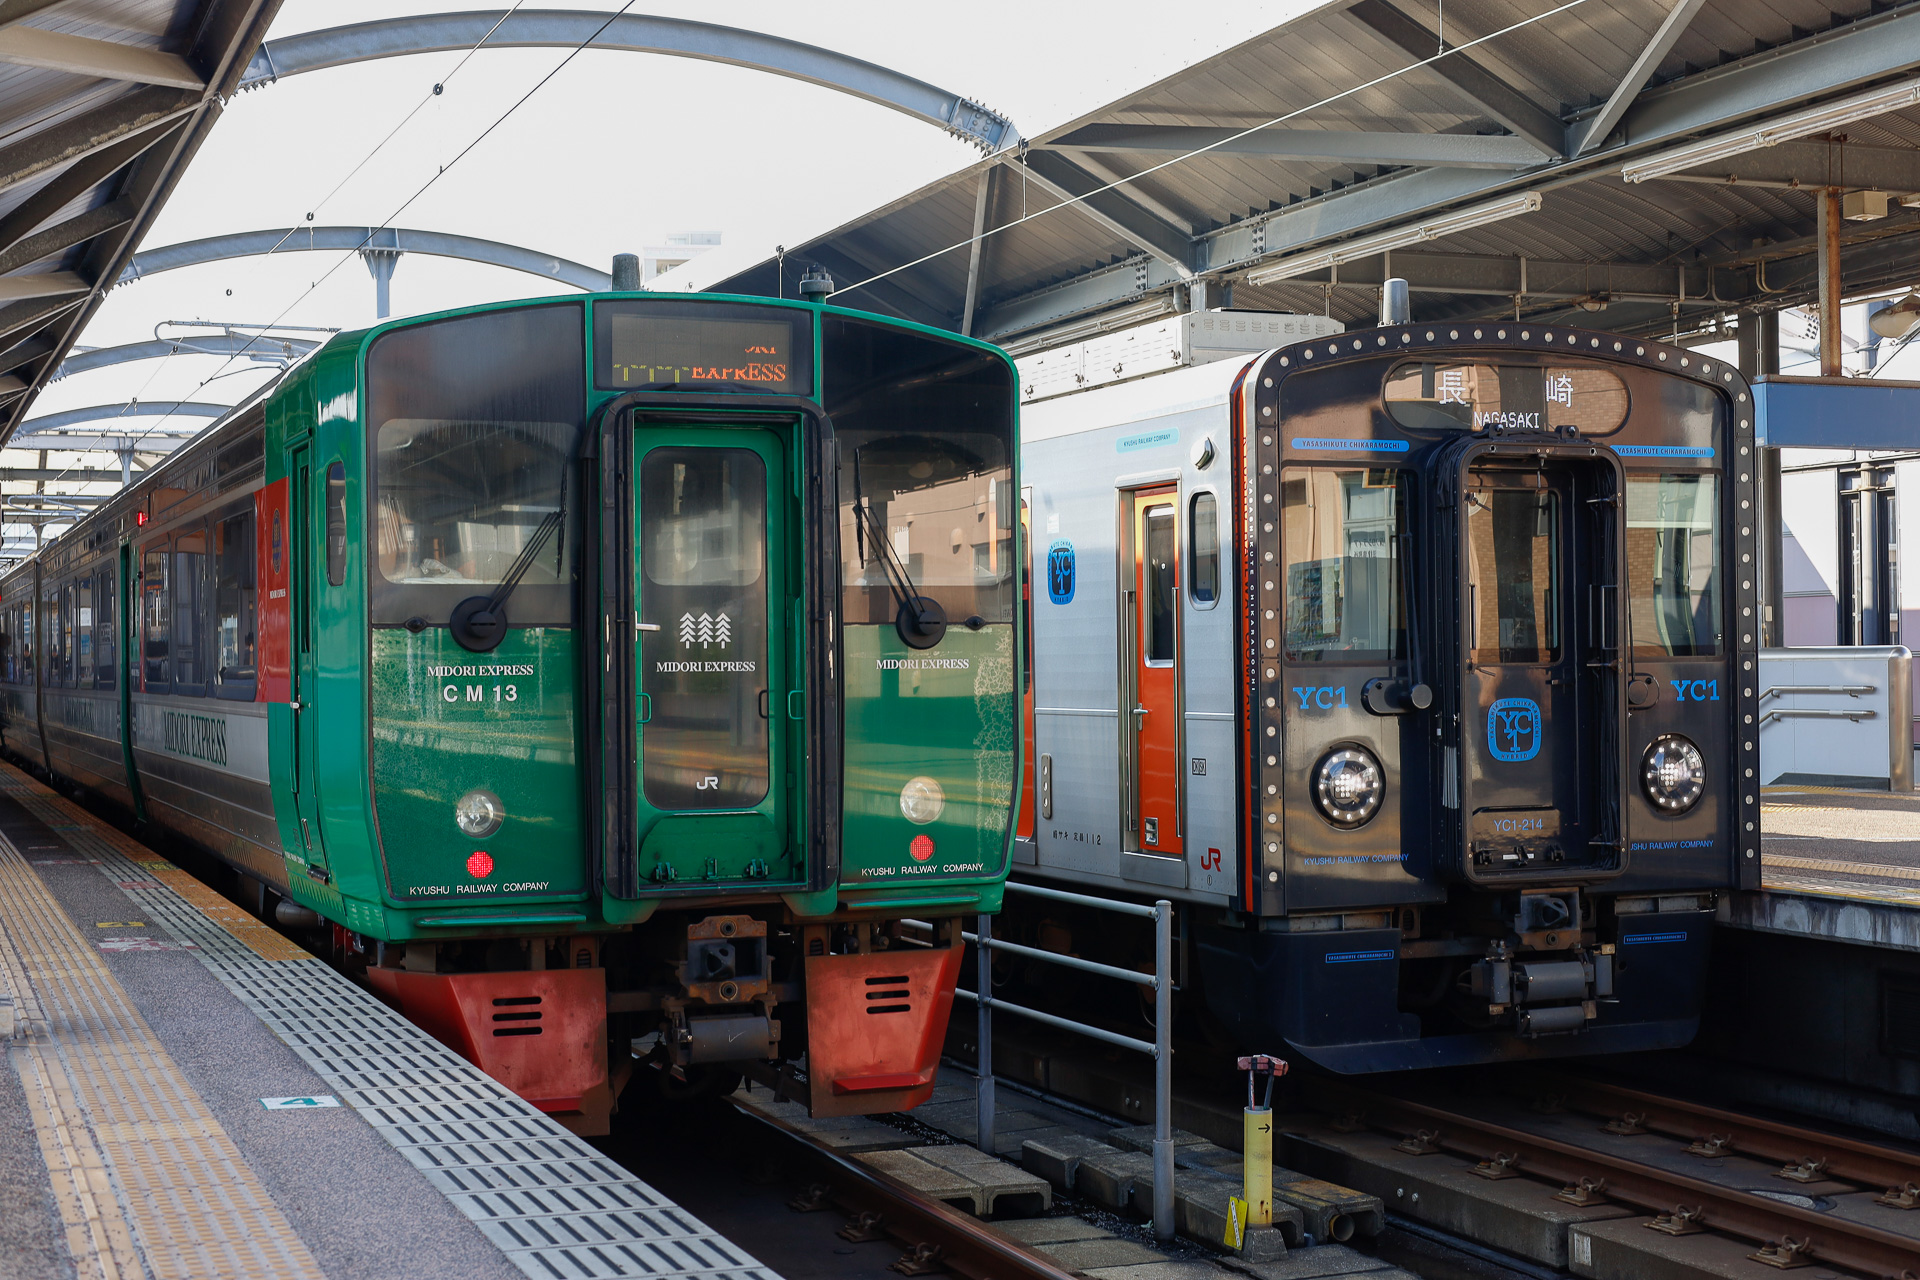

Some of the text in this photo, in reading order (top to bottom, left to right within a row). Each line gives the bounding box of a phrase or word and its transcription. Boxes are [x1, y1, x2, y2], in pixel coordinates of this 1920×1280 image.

[1437, 371, 1573, 408] 長崎
[1474, 412, 1540, 428] NAGASAKI
[1154, 434, 1170, 442] COMPANY
[1302, 440, 1400, 449] YASASHIKUTE CHIKARAMOCHI
[427, 664, 534, 677] MIDORI EXPRESS
[656, 661, 756, 673] MIDORI EXPRESS
[876, 658, 970, 670] MIDORI EXPRESS
[443, 684, 518, 702] C M 13
[1293, 686, 1348, 709] YC1
[1670, 680, 1720, 701] YC1
[164, 711, 227, 767] MIDORI EXPRESS
[696, 776, 718, 790] JR
[1494, 818, 1543, 832] YC1-214
[1680, 840, 1714, 848] COMPANY
[1200, 847, 1221, 872] JR
[1304, 853, 1409, 866] KYUSHU RAILWAY COMPANY
[861, 863, 984, 876] KYUSHU RAILWAY COMPANY
[409, 881, 549, 895] KYUSHU RAILWAY COMPANY
[280, 1098, 324, 1106] 4
